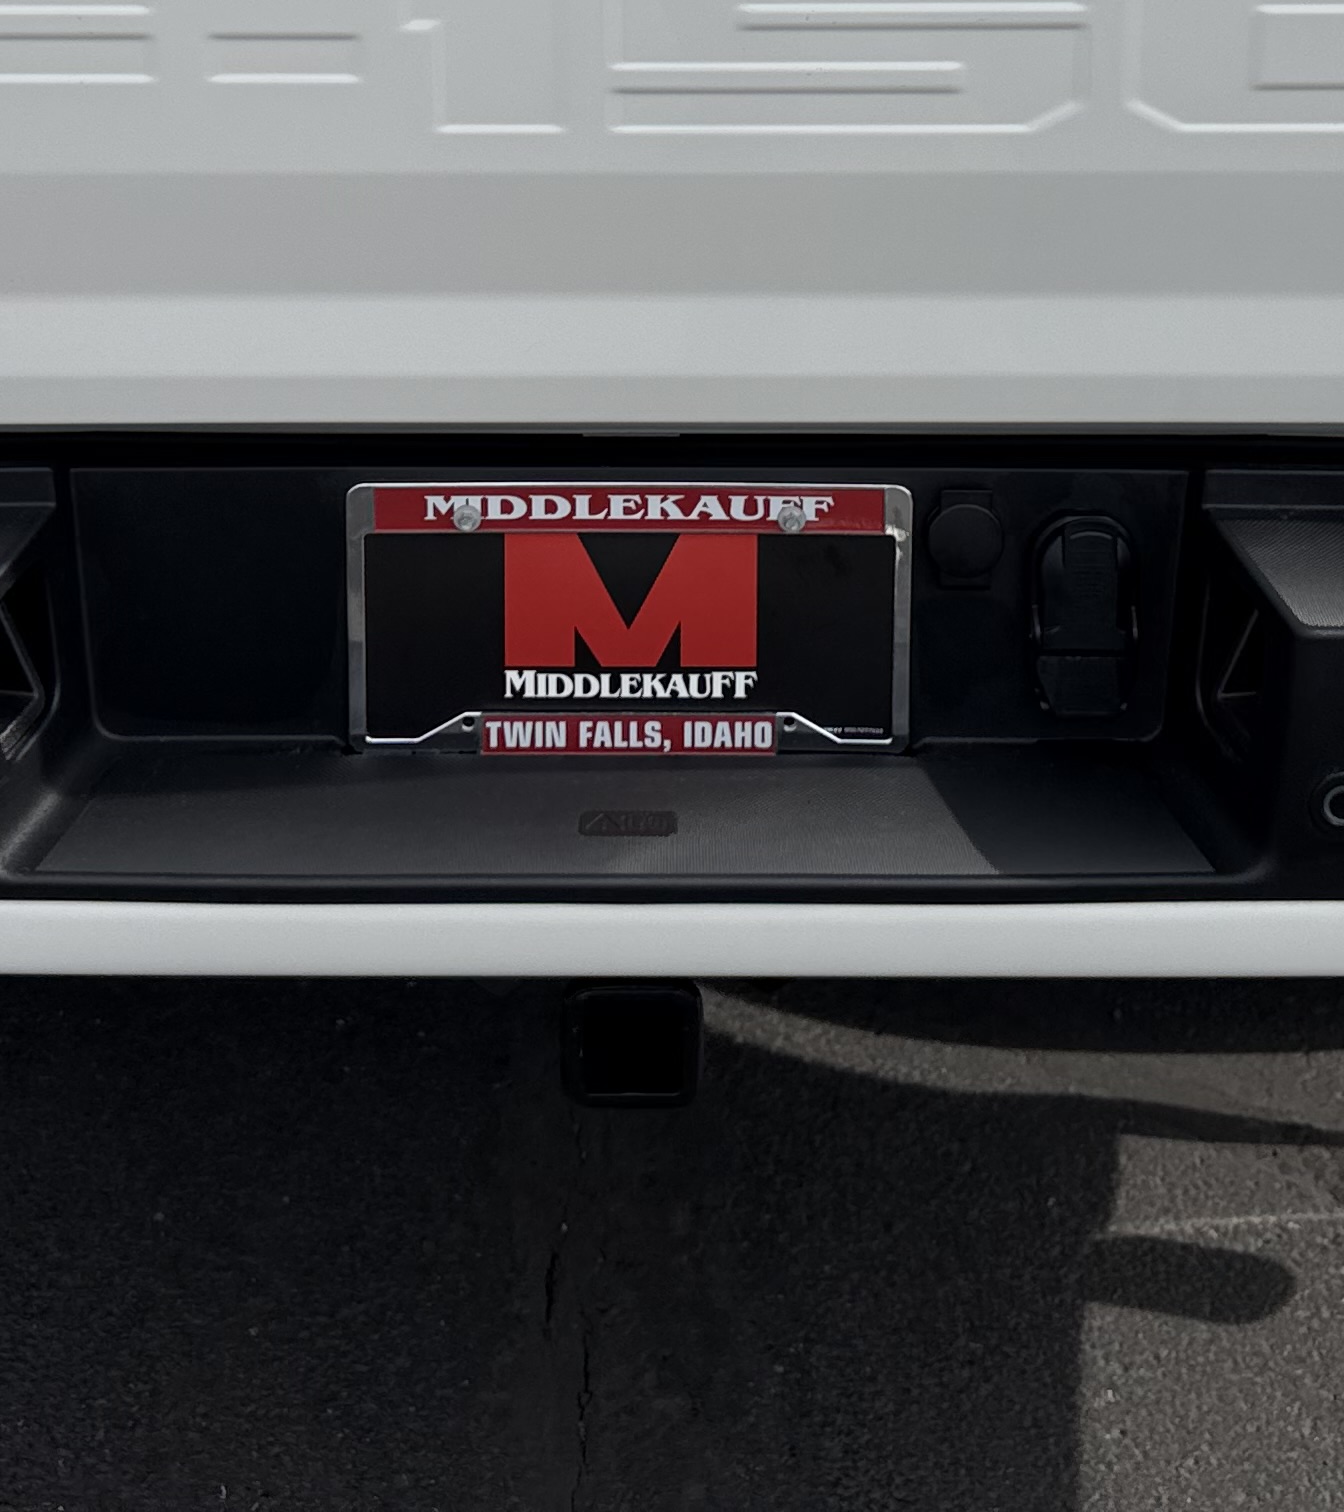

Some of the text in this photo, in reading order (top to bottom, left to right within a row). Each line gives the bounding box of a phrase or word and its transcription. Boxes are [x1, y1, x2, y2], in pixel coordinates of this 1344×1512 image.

[504, 533, 757, 667] M
[504, 669, 758, 700] MIDDLEKAUFF
[485, 720, 773, 753] TWIN FALLS, IDAHO
